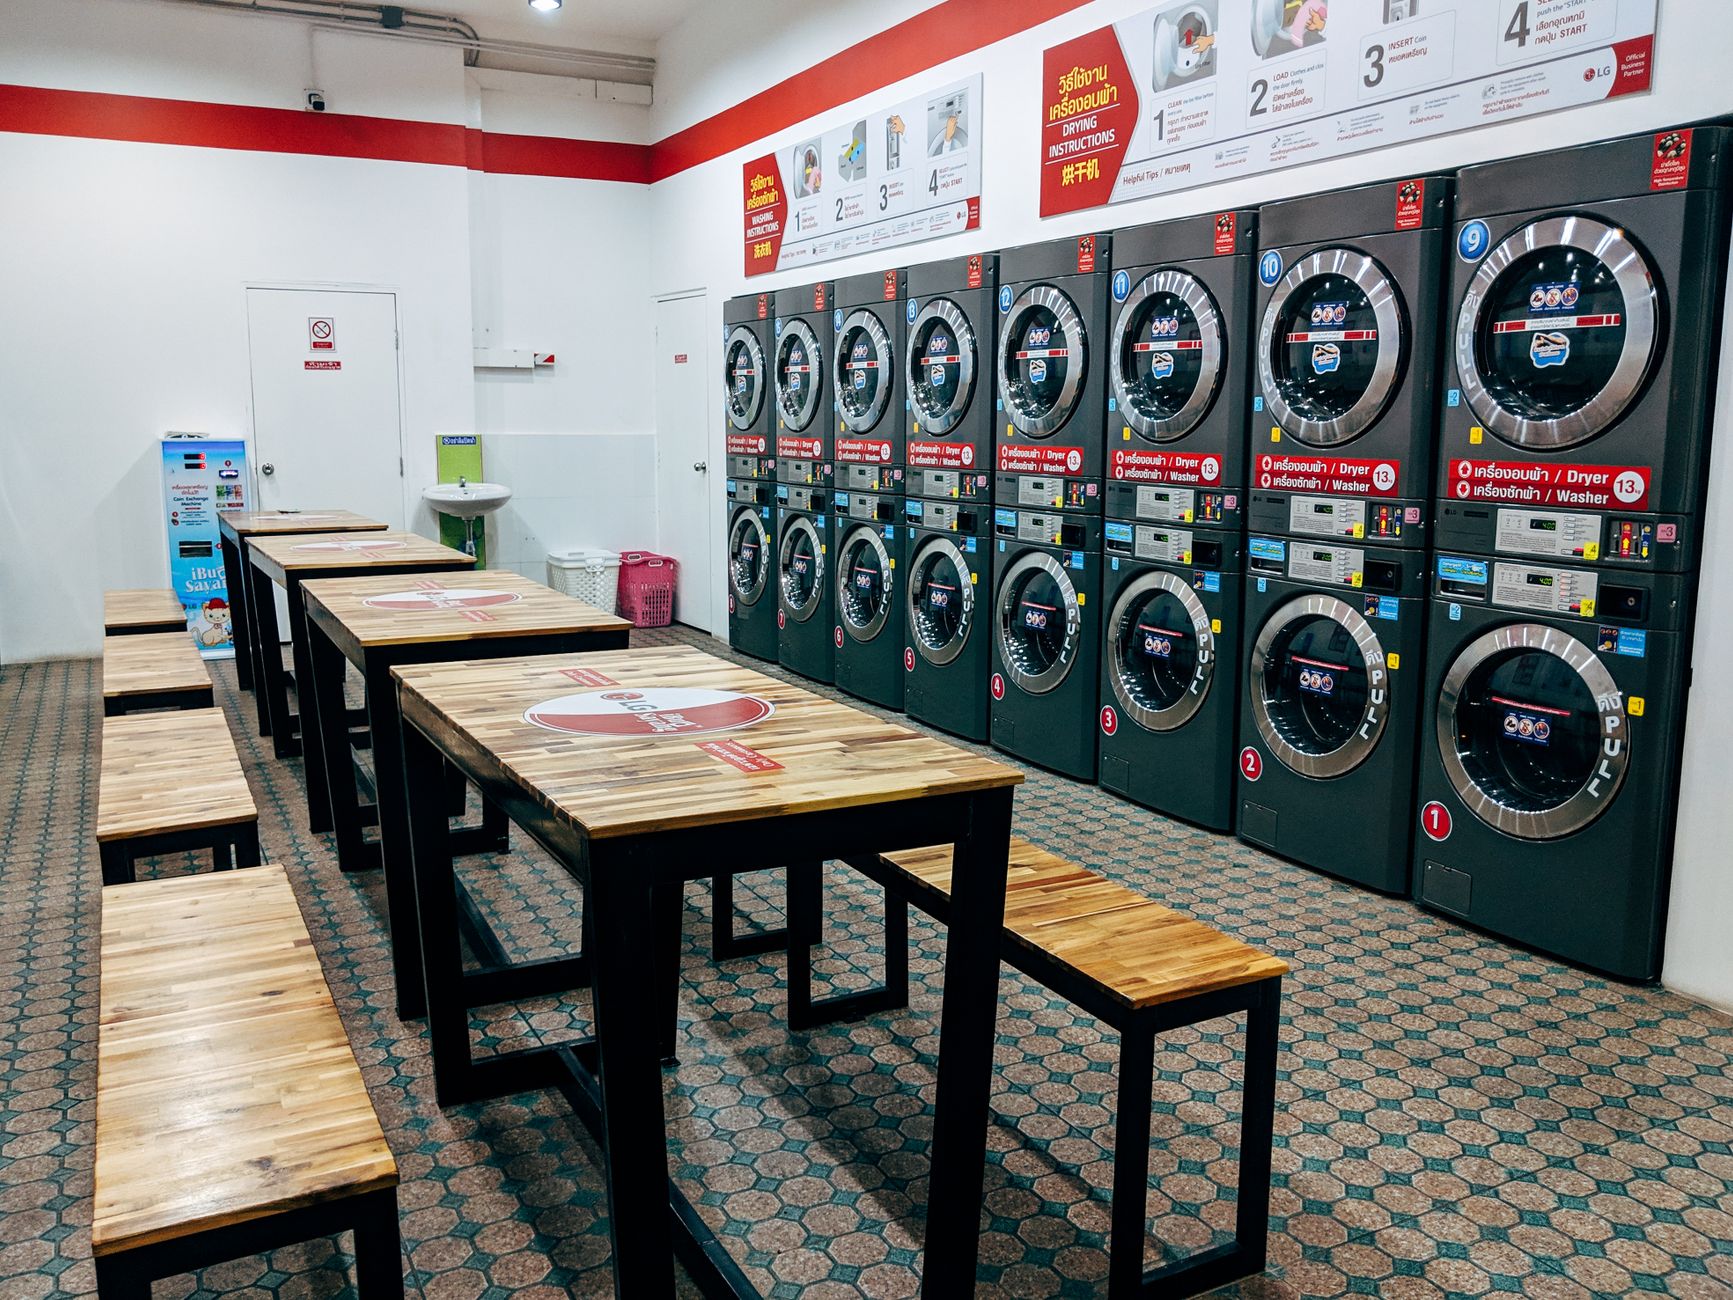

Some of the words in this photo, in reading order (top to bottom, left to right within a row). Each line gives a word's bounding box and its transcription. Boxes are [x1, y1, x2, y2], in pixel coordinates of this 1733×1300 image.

[1504, 1, 1530, 48] 4
[1560, 24, 1588, 38] START
[1388, 36, 1414, 50] INSERT
[1364, 44, 1384, 88] 3
[1621, 60, 1645, 70] Business
[1626, 52, 1646, 62] Official
[1058, 64, 1108, 94] วิธีใช้งาน
[1273, 72, 1288, 82] LOAD
[1597, 66, 1611, 78] LG
[1624, 68, 1644, 78] Partner
[1050, 82, 1118, 120] เครื่องอบผ้า
[1250, 79, 1268, 117] 2
[1062, 115, 1098, 137] DRYING
[1154, 109, 1164, 141] 1
[1049, 128, 1115, 158] INSTRUCTIONS
[1062, 158, 1100, 186] 烘干机
[1123, 172, 1144, 185] Helpful
[1146, 170, 1158, 180] Tips
[929, 169, 938, 196] 4
[880, 184, 888, 211] 3
[752, 211, 773, 226] WASHING
[836, 198, 843, 221] 2
[747, 221, 779, 238] INSTRUCTIONS
[795, 211, 800, 232] 1
[1468, 228, 1480, 252] 9
[1264, 258, 1278, 278] 10
[1115, 277, 1126, 294] 11
[1002, 290, 1010, 307] 12
[1260, 329, 1274, 392] PULL
[1460, 312, 1477, 390] PULL
[946, 446, 960, 455] Dryer
[1047, 451, 1065, 461] Dryer
[943, 458, 960, 466] Washer
[1043, 463, 1066, 472] Washer
[1124, 452, 1166, 466] เครื่องอบผ้า
[1175, 457, 1199, 469] Dryer
[1273, 457, 1326, 473] เครื่องอบผ้า
[1340, 463, 1370, 476] Dryer
[1124, 466, 1162, 479] เครื่องซักผ้า
[1170, 471, 1199, 482] Washer
[1273, 473, 1321, 489] เครื่องซักผ้า
[1332, 480, 1370, 492] Washer
[1474, 462, 1549, 482] เครื่องอบผ้า
[1567, 470, 1608, 487] Dryer
[1473, 480, 1540, 500] เครื่องซักผ้า
[1556, 489, 1609, 504] Washer
[879, 570, 890, 615] PULL
[958, 588, 970, 637] PULL
[837, 631, 841, 641] 6
[1060, 608, 1076, 664] PULL
[907, 653, 912, 665] 5
[1190, 633, 1209, 695] PULL
[994, 682, 1000, 692] 4
[619, 700, 658, 711] LG
[1360, 670, 1384, 740] PULL
[1105, 712, 1112, 728] 3
[1246, 754, 1255, 771] 2
[1587, 715, 1621, 798] PULL
[1431, 809, 1439, 830] 1
